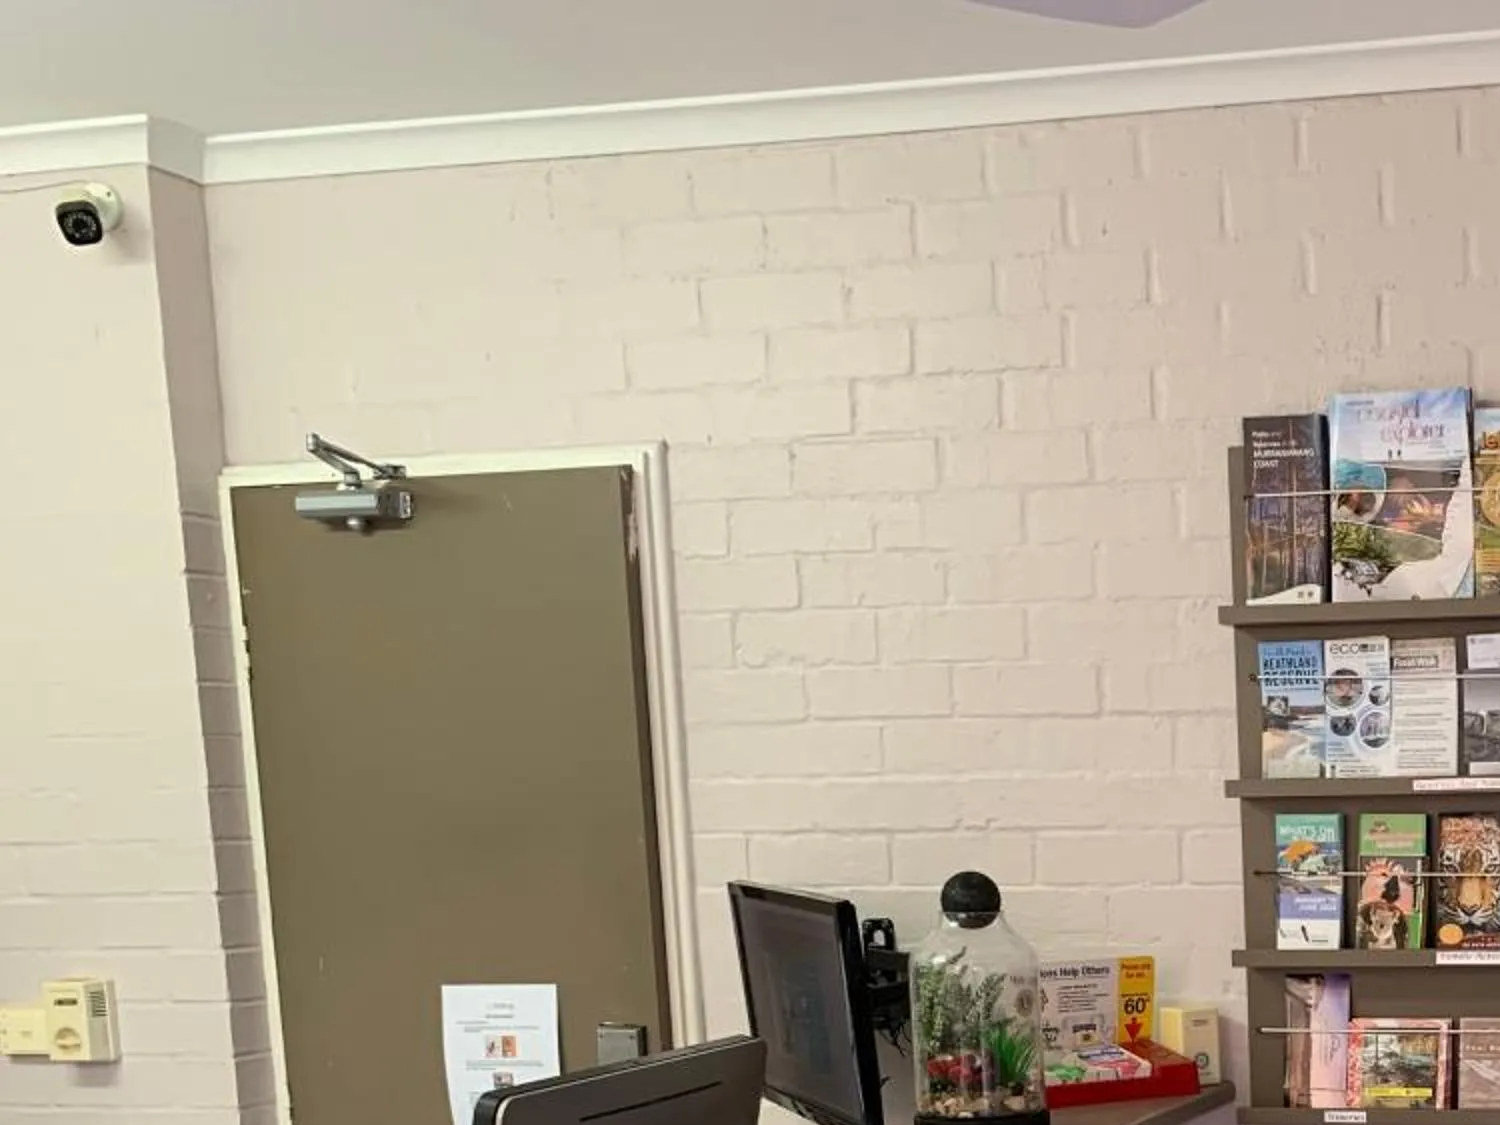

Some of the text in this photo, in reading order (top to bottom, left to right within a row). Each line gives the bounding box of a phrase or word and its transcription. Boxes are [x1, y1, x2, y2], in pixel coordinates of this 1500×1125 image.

[1060, 967, 1080, 978] Help
[1082, 965, 1111, 976] Others
[1123, 998, 1147, 1015] 60
